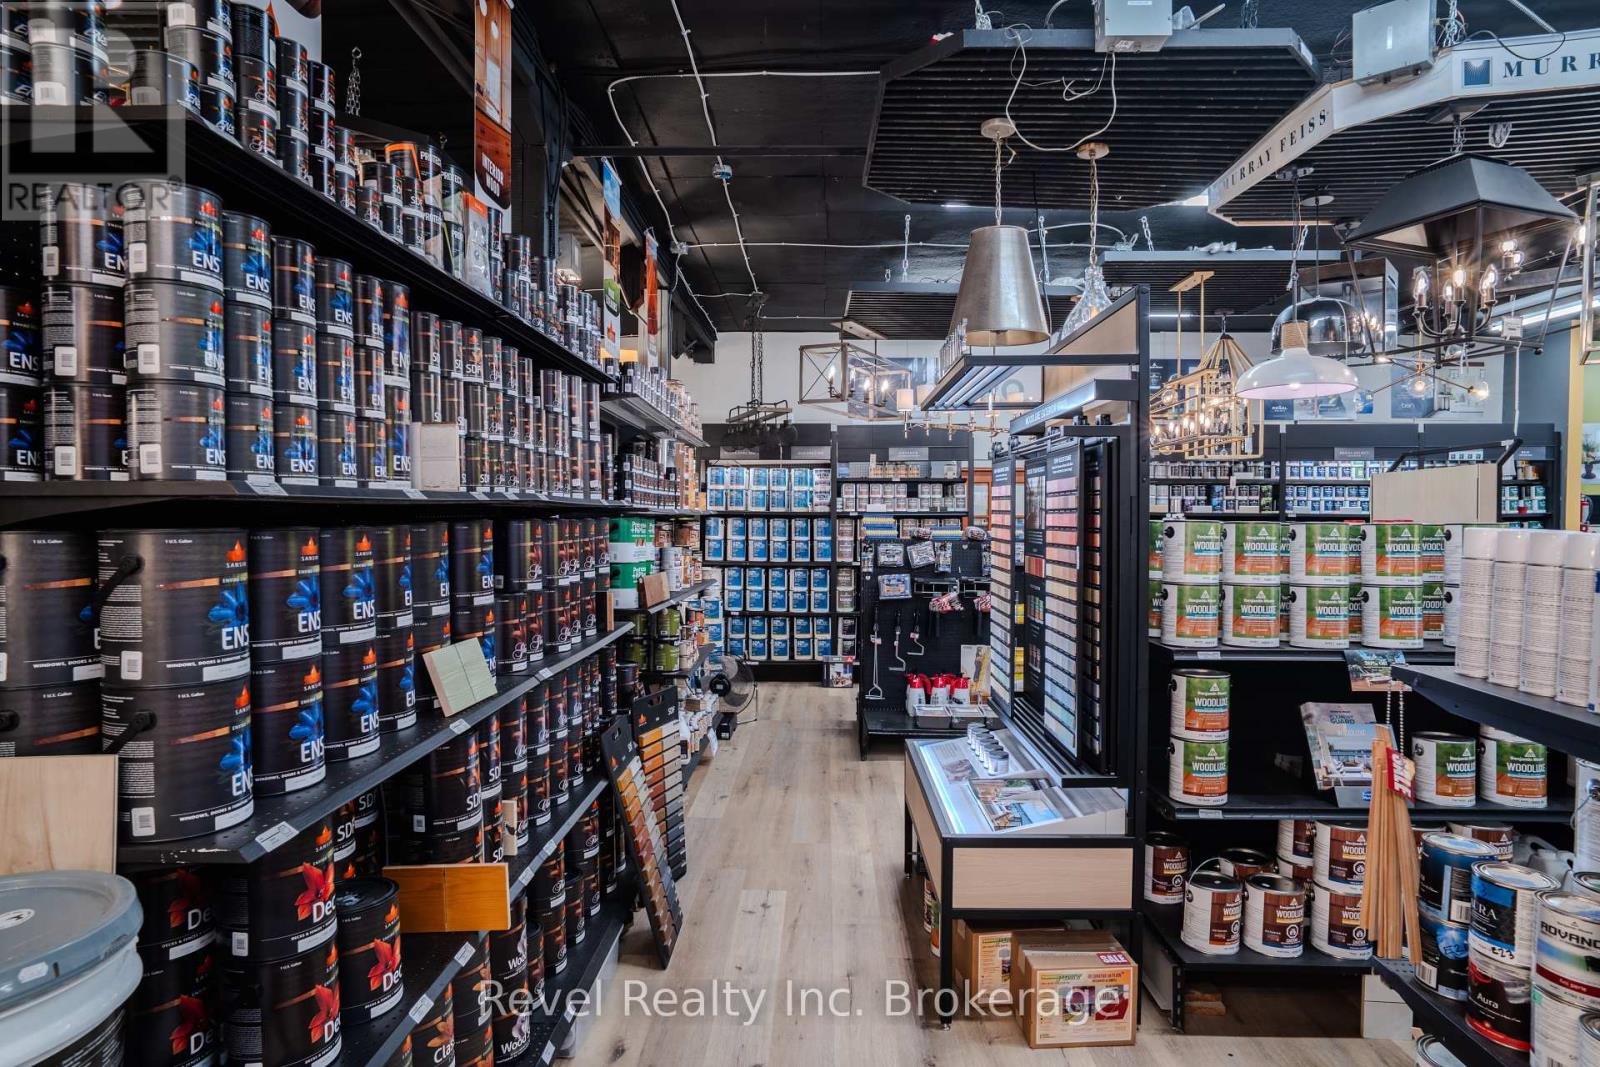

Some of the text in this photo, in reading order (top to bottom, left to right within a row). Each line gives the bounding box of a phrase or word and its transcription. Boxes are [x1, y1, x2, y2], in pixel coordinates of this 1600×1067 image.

[1280, 109, 1326, 152] FEISS
[481, 152, 504, 187] INTERIOR
[486, 172, 500, 197] WOOD
[192, 250, 221, 273] ENS
[246, 273, 270, 293] ENS
[290, 459, 316, 473] ENS
[353, 600, 375, 620] ENS
[298, 610, 321, 633] ENS
[221, 624, 249, 650] ENS
[1507, 762, 1546, 772] WOODLUXE
[1100, 954, 1128, 963] SALE
[1476, 992, 1499, 1009] Aura
